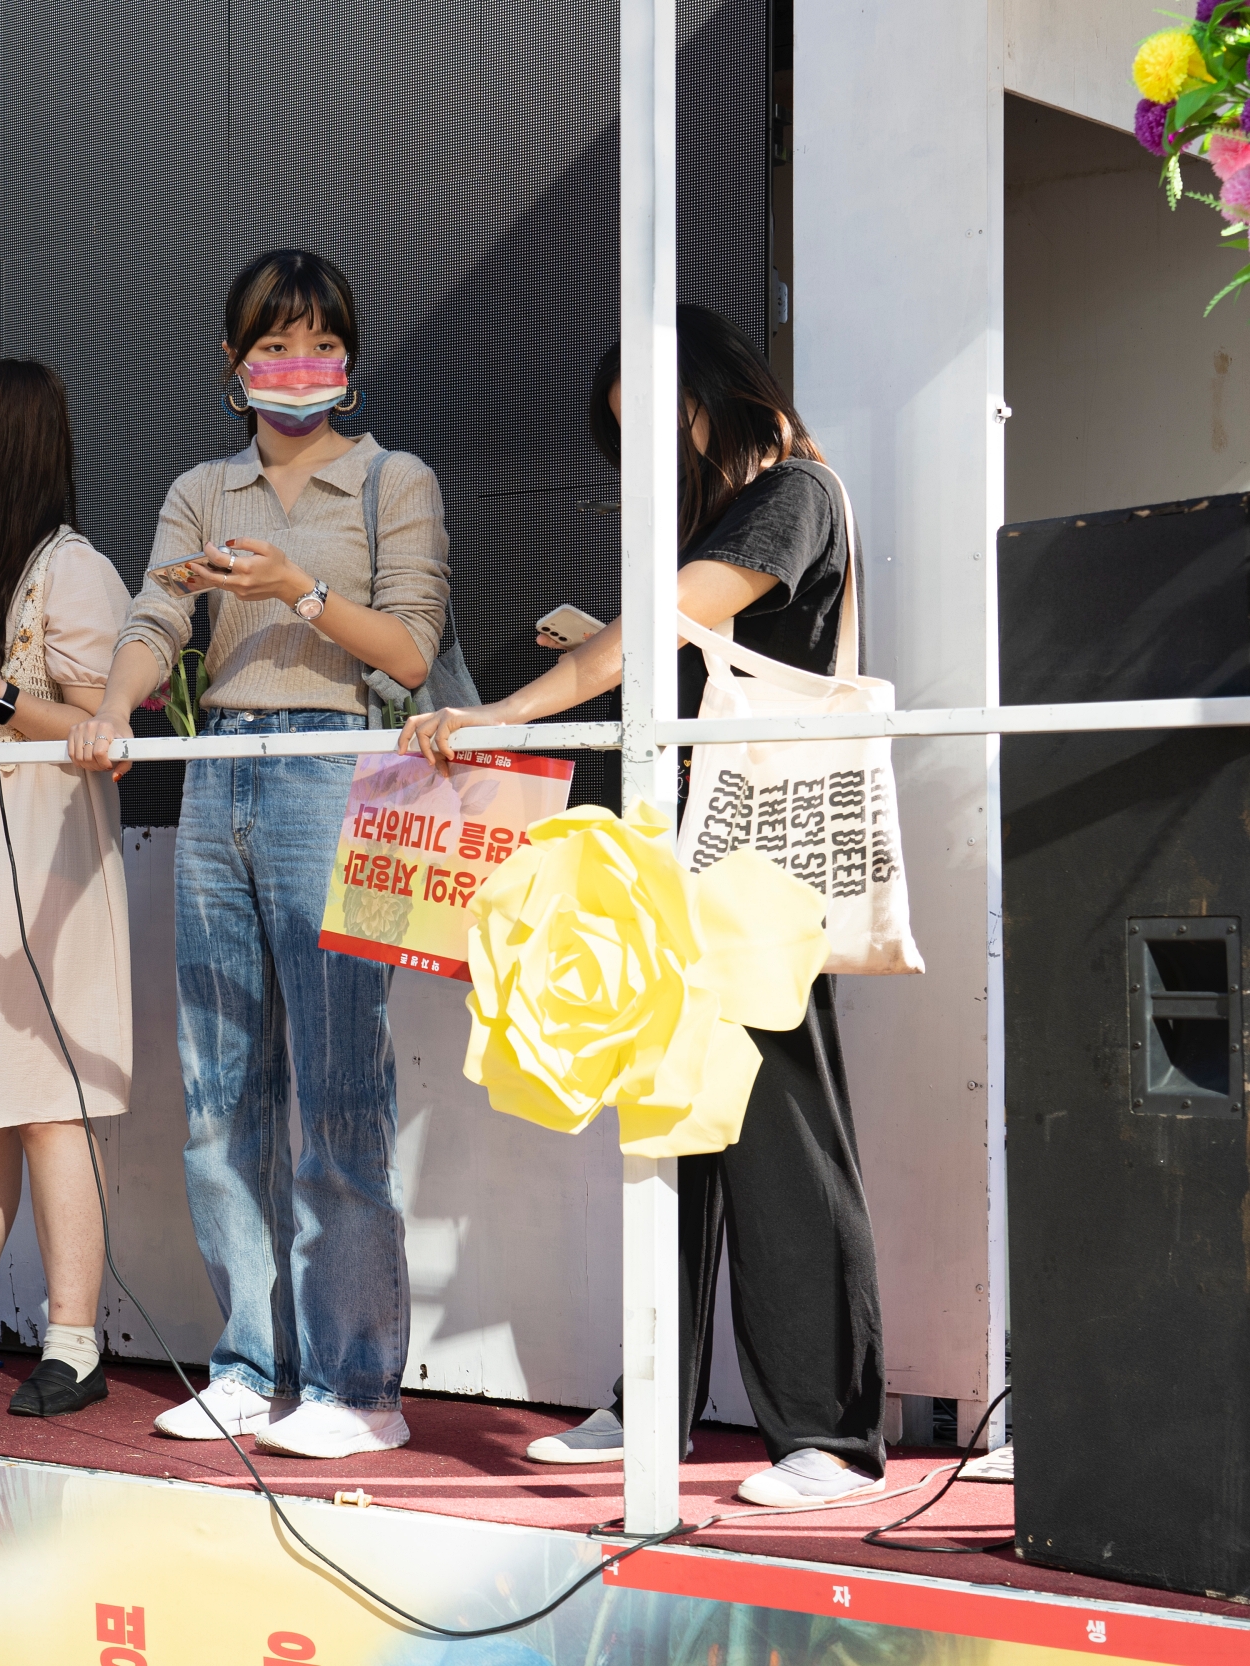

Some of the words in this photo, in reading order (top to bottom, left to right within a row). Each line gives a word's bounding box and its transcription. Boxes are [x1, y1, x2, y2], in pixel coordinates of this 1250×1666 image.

[689, 769, 746, 874] DISCOU
[755, 778, 789, 852] THEN
[790, 776, 826, 849] EASY
[829, 769, 866, 824] NOT
[353, 803, 452, 854] 기대하라
[458, 821, 532, 864] 명을
[344, 850, 418, 897] 저항과
[423, 865, 488, 908] 상의
[831, 827, 867, 898] BEEN
